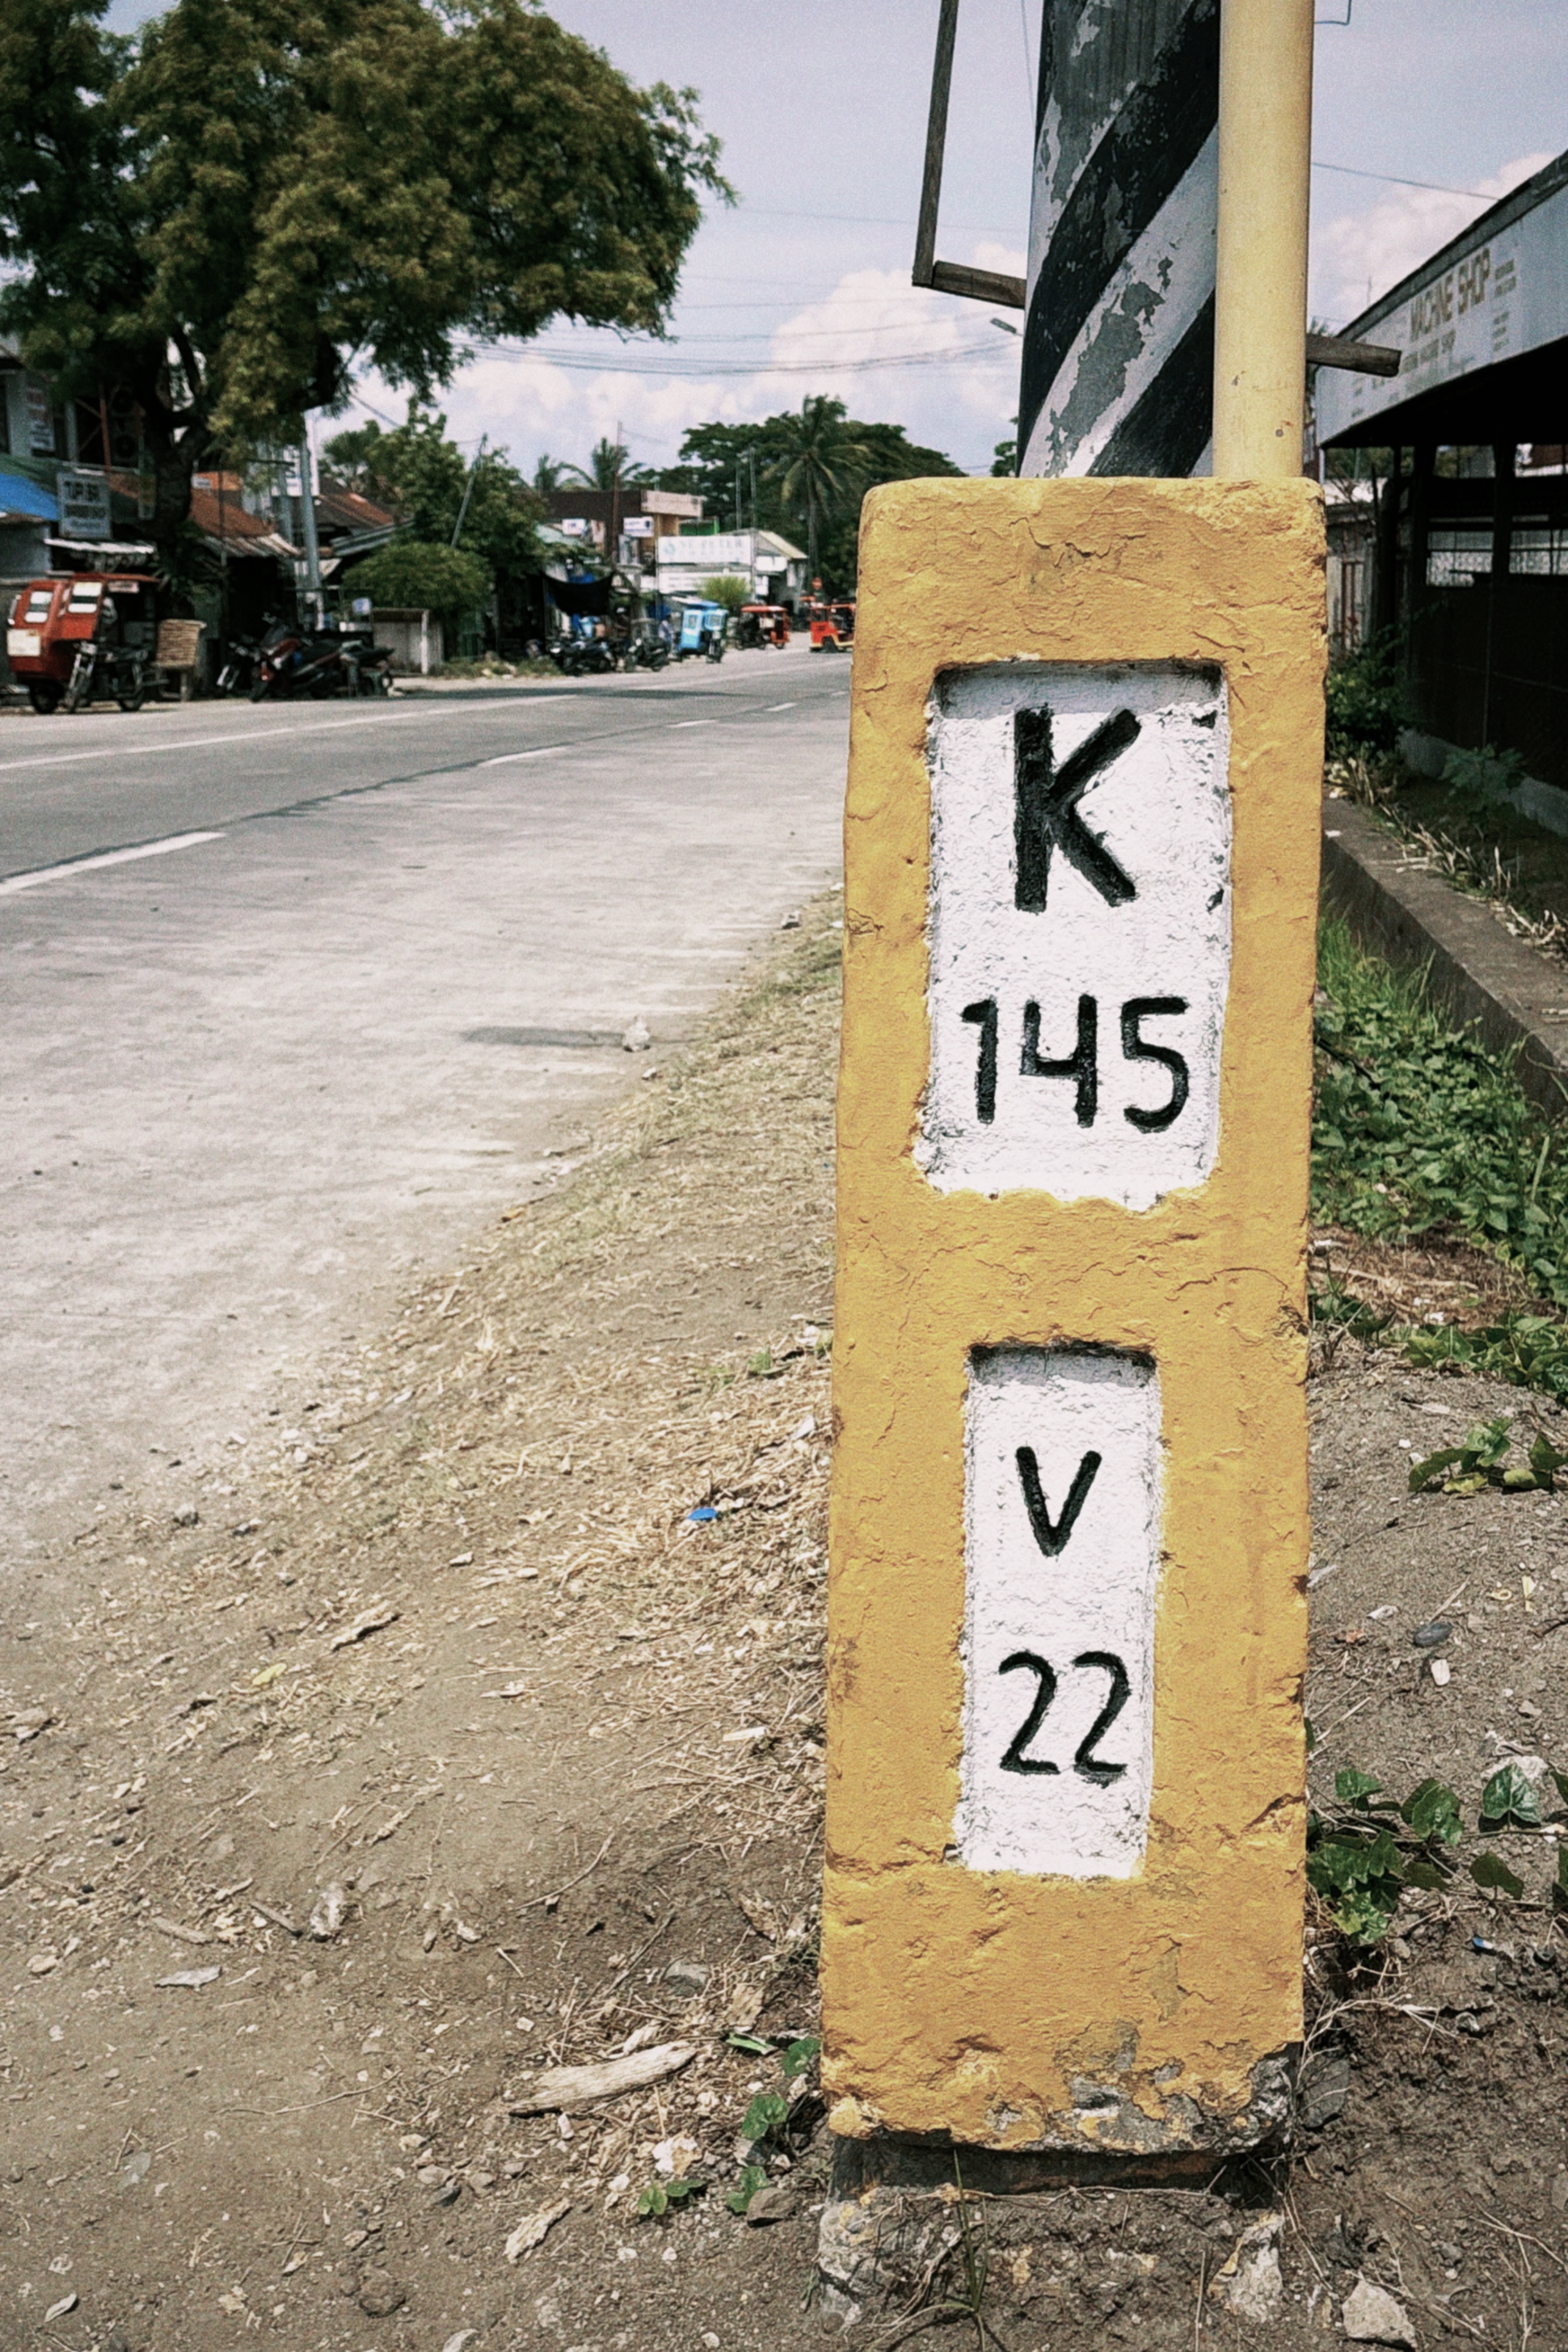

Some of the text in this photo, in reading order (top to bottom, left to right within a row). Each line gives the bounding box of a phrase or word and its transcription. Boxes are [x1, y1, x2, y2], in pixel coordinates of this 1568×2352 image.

[1458, 247, 1491, 316] SHOP
[1013, 703, 1142, 914] K
[960, 993, 1191, 1134] 145
[1014, 1445, 1103, 1558] V
[998, 1650, 1132, 1784] 22
